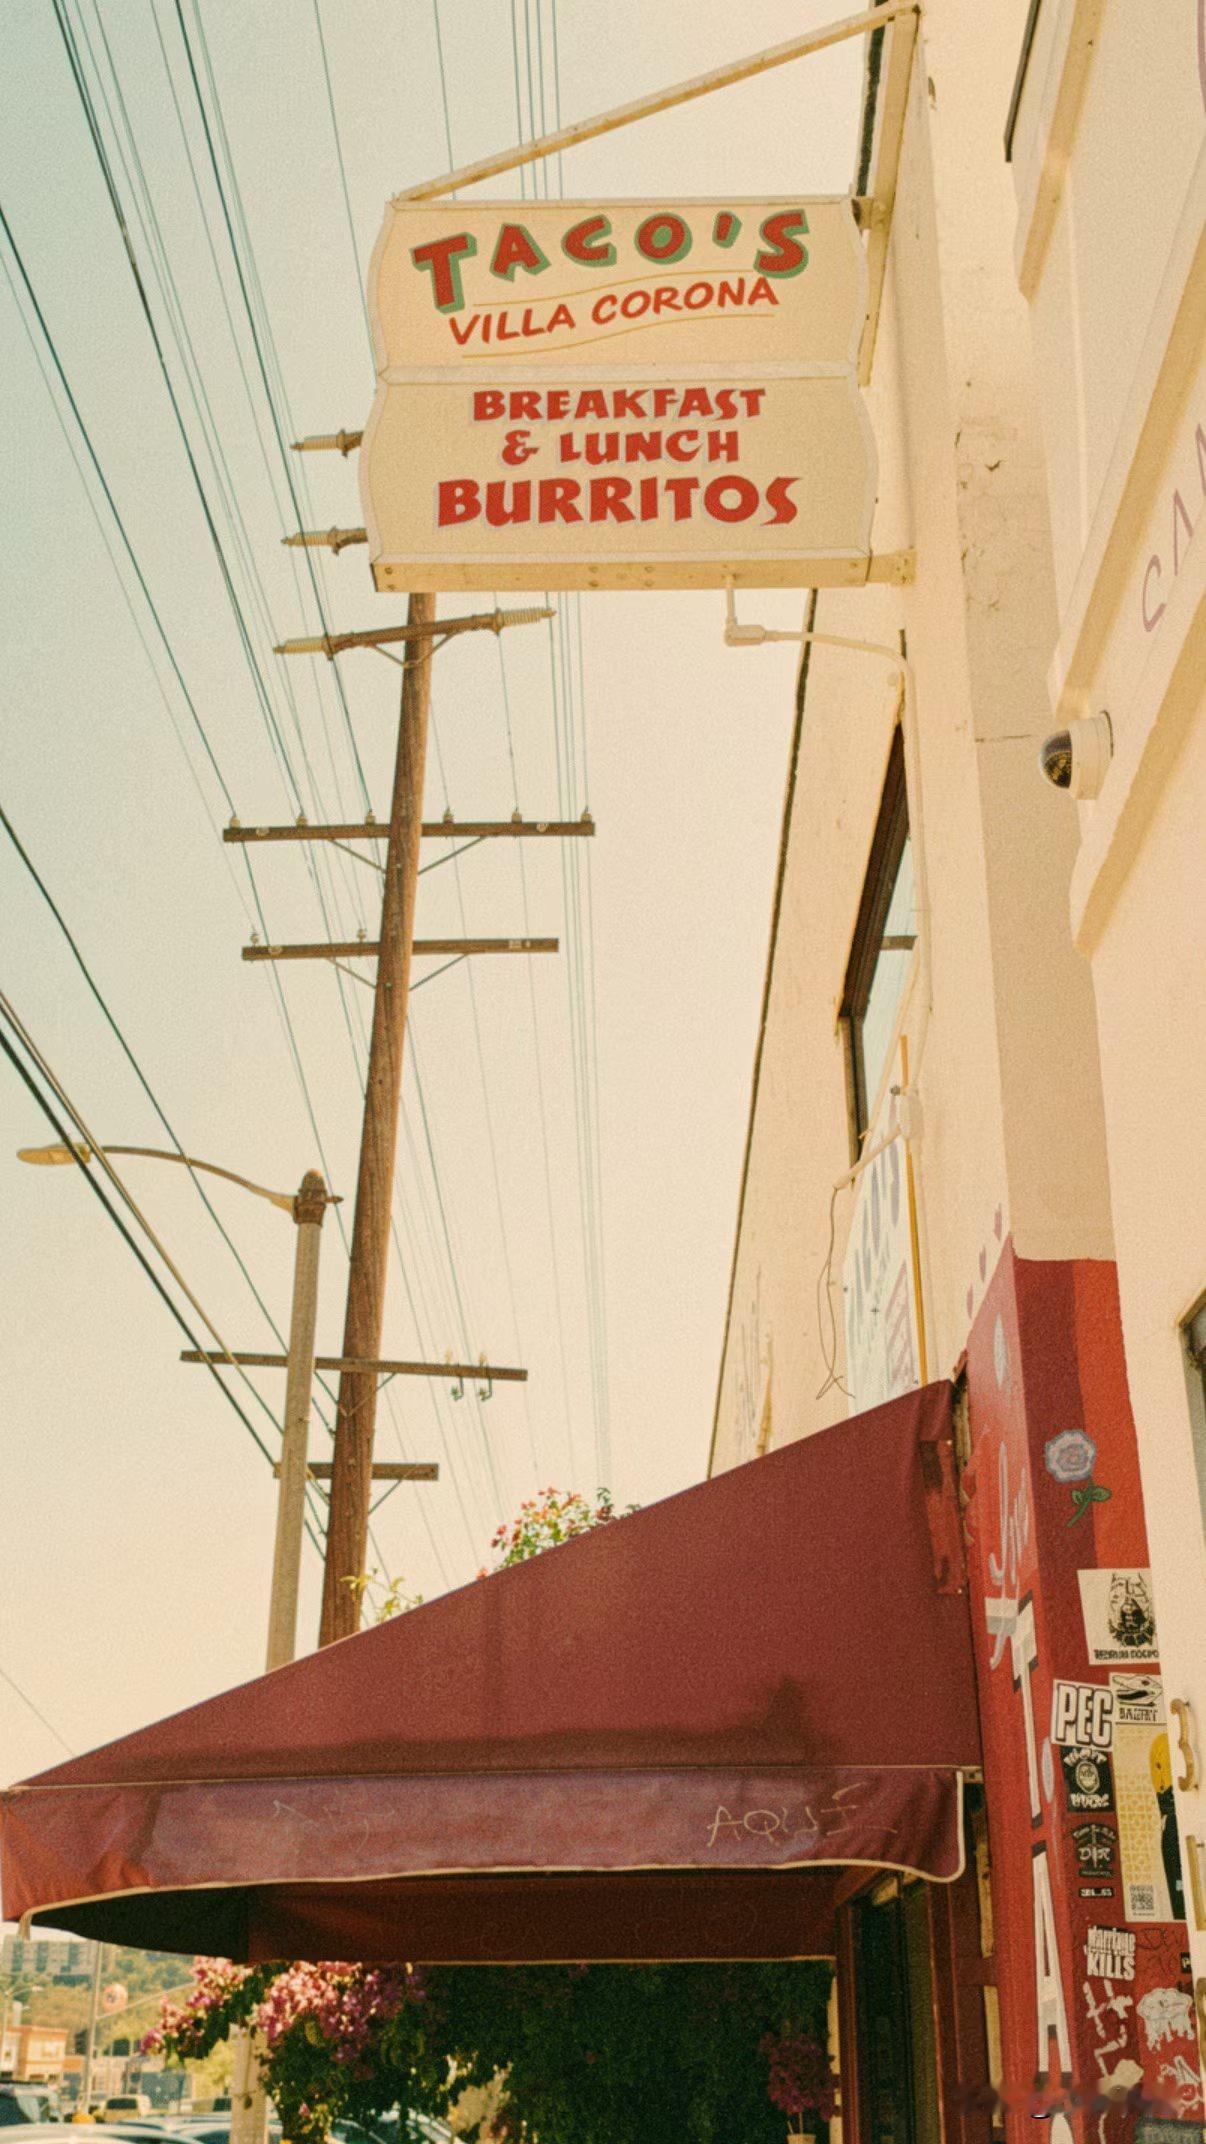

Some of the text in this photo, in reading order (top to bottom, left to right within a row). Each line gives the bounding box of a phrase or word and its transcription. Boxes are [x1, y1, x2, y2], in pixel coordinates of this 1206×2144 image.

[410, 208, 810, 314] TACO'S
[448, 276, 780, 346] VILLA CORONA
[472, 387, 767, 422] BREAKFAST
[501, 429, 740, 467] & LUNCH
[437, 475, 801, 528] BURRITOS
[1056, 1683, 1113, 1748] PEC
[1087, 1951, 1135, 1981] KILLS
